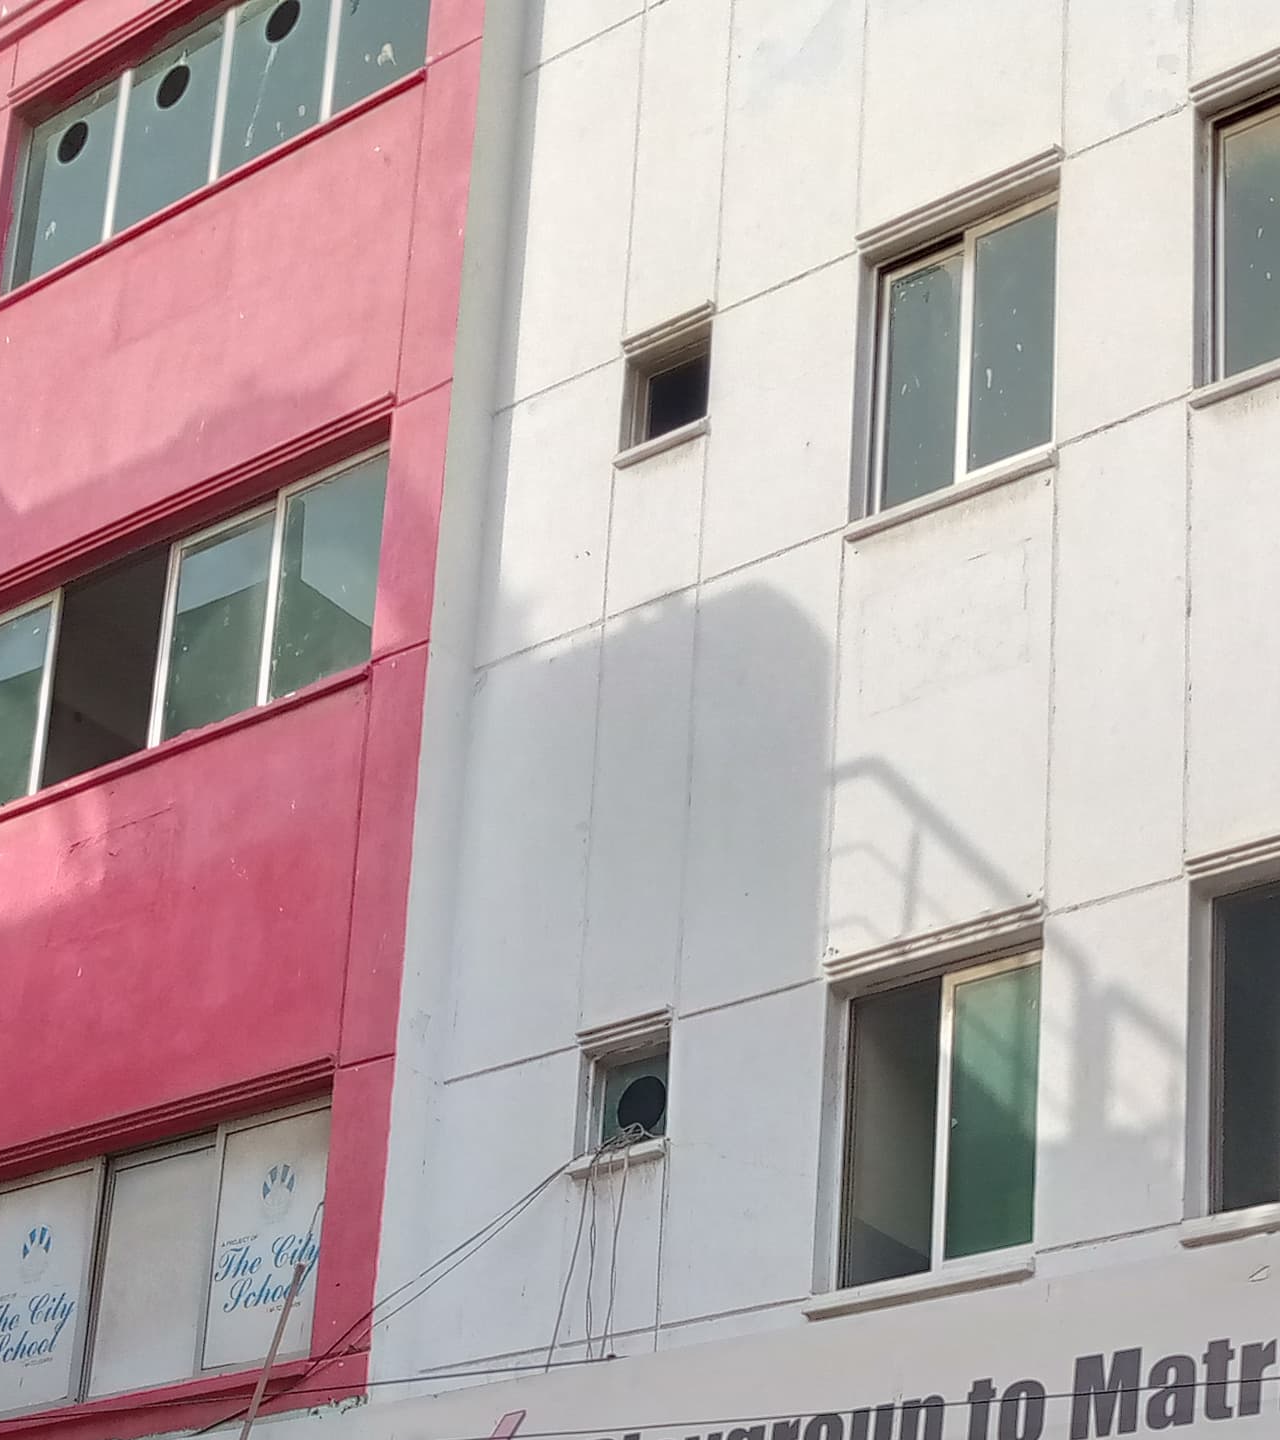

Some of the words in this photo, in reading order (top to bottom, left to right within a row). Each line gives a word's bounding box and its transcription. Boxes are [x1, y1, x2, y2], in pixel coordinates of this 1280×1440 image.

[214, 1245, 262, 1282] The
[272, 1231, 320, 1274] City
[28, 1292, 76, 1334] City
